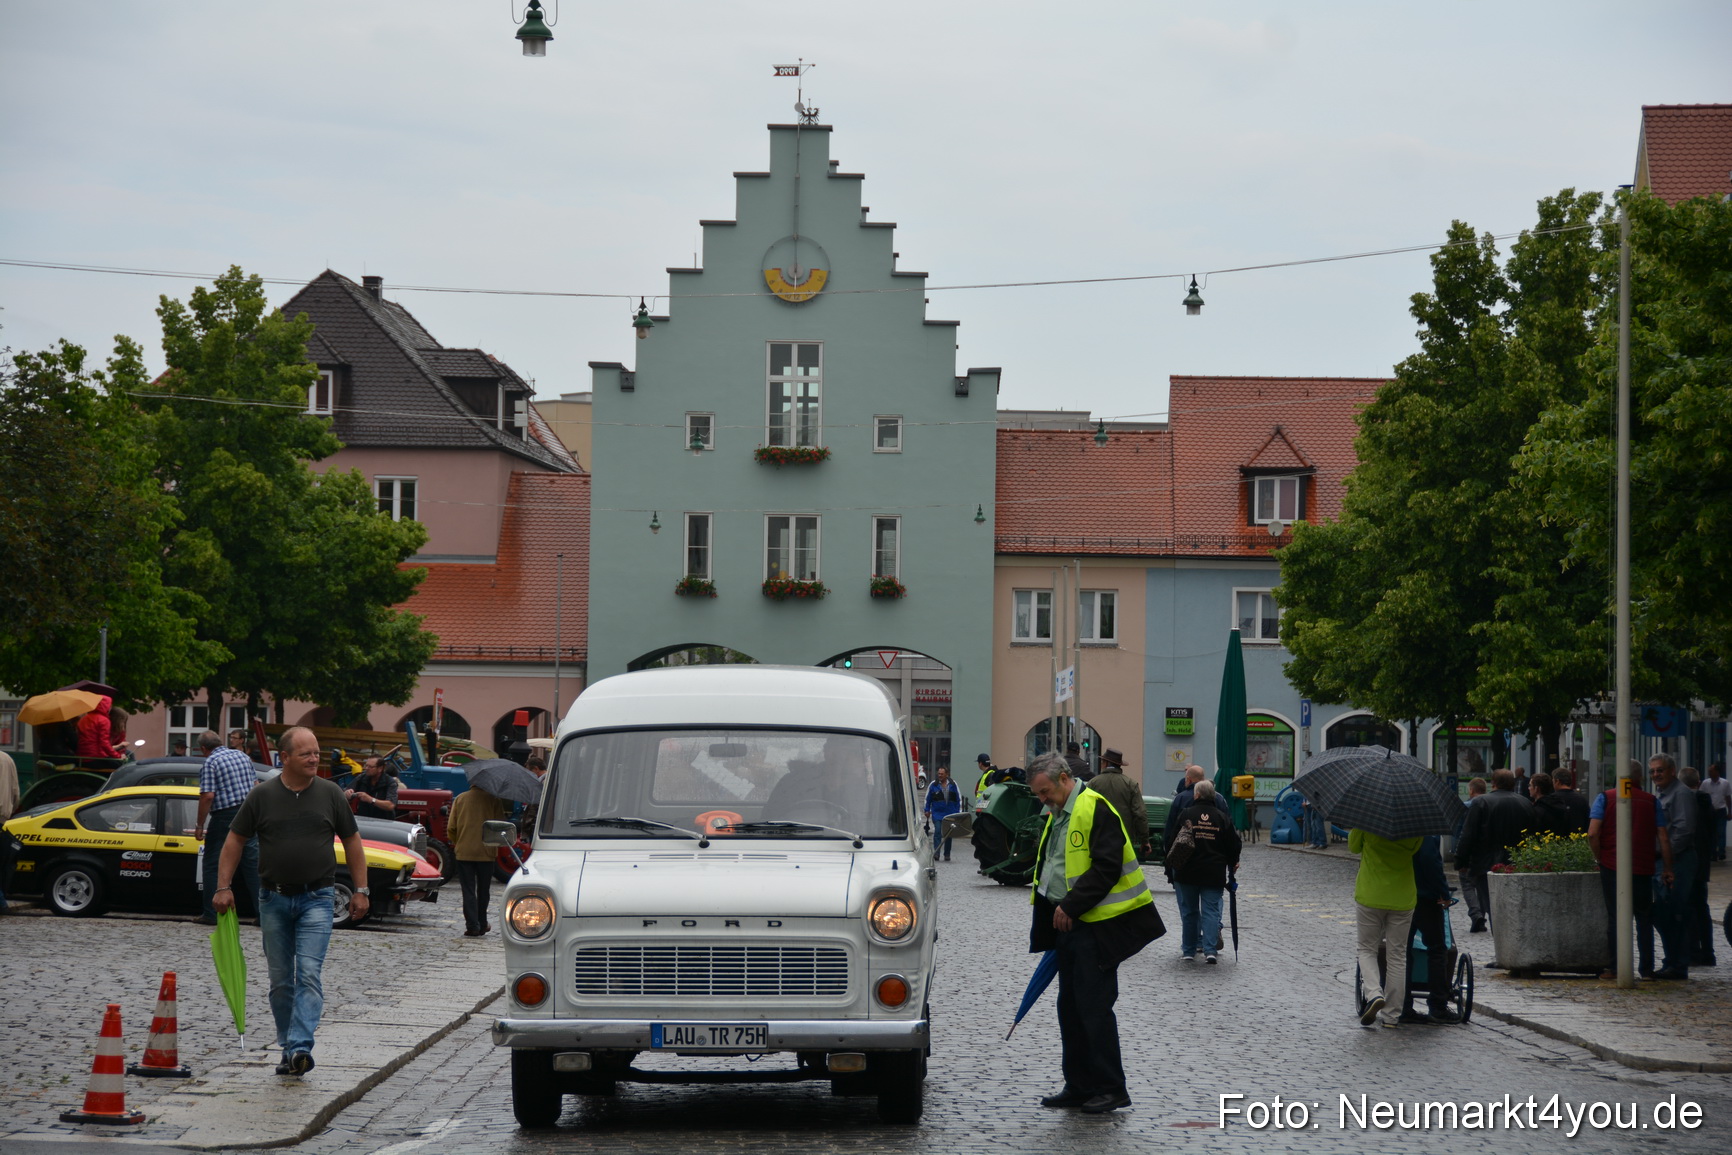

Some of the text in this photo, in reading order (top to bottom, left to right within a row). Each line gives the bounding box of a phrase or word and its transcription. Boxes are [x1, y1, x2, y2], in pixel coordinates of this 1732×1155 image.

[1302, 702, 1309, 723] P
[67, 837, 124, 845] HÄNDLERTEAM
[120, 861, 152, 870] BOSCH
[120, 870, 151, 878] RECARO
[642, 919, 783, 928] FORD
[663, 1026, 696, 1045] LAU
[708, 1027, 730, 1045] TR
[734, 1027, 766, 1045] 75H
